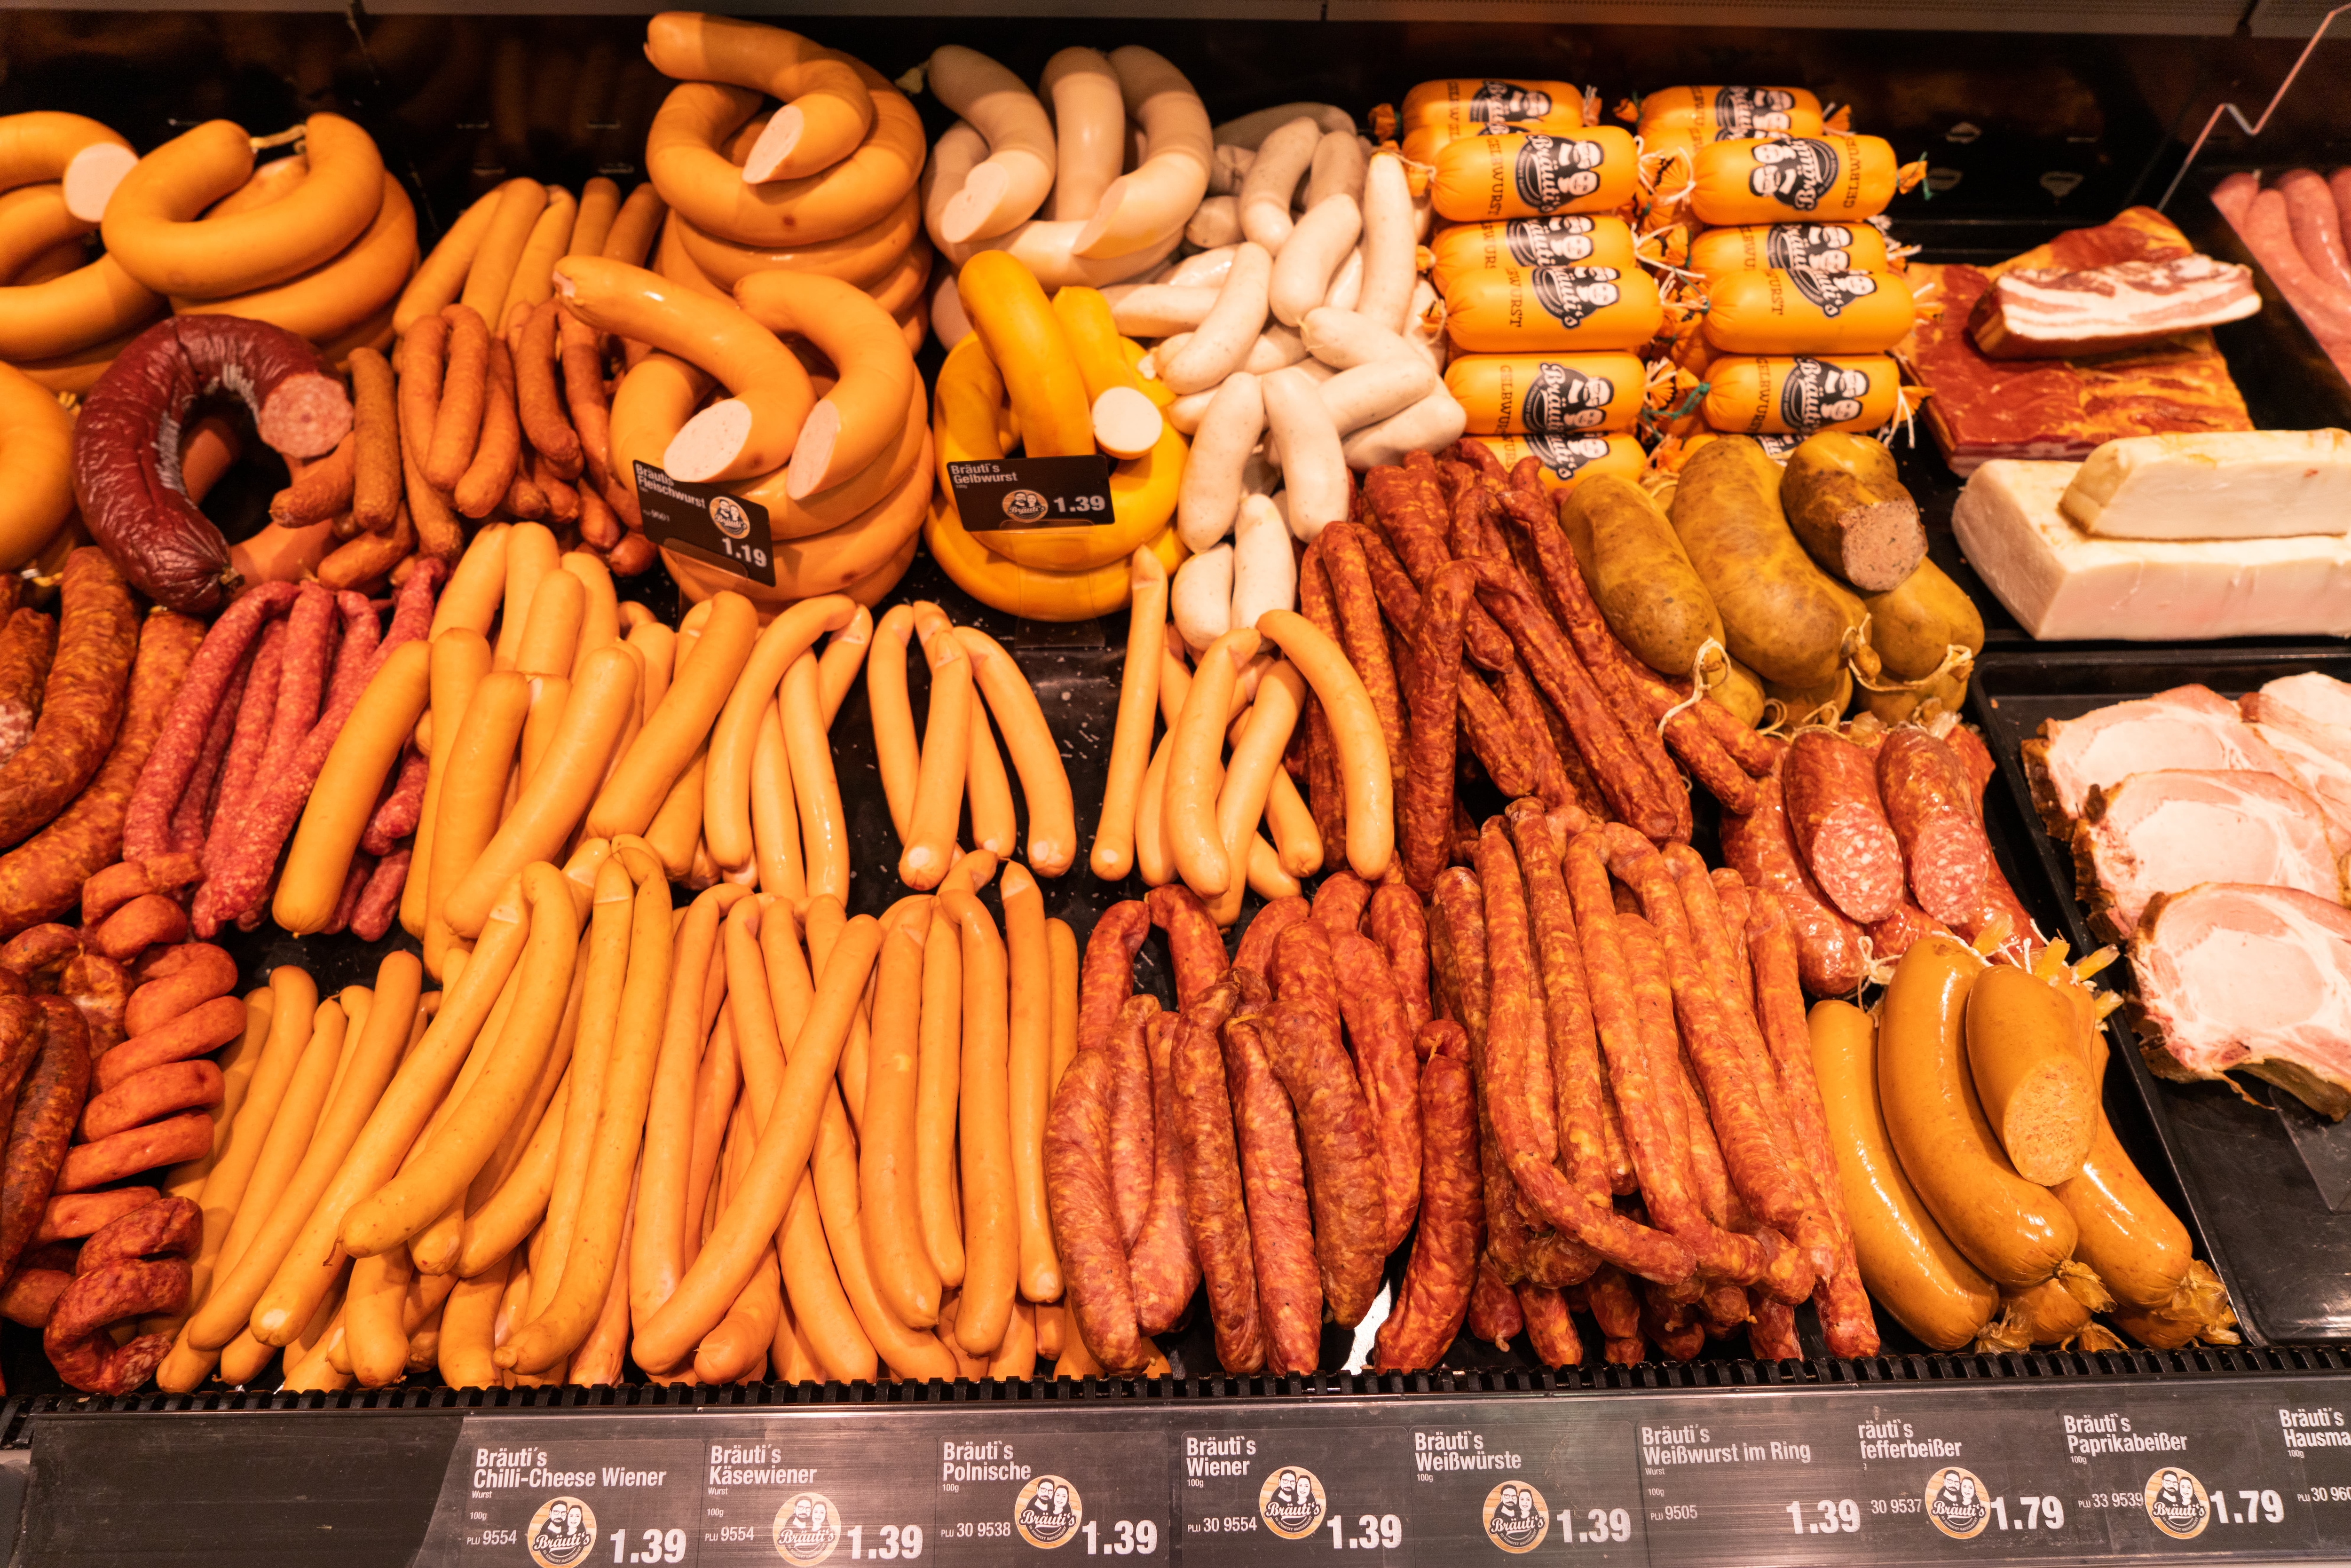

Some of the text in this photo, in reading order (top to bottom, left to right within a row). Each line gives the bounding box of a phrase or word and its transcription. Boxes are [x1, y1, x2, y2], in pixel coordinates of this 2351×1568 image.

[953, 472, 1018, 484] Gelbwurst
[637, 475, 706, 509] Fleischwurst
[1054, 495, 1105, 512] 1.39
[722, 537, 767, 567] 1.19
[2067, 1432, 2187, 1457] Paprikabeißer
[2283, 1429, 2351, 1447] Hausma
[1643, 1441, 1811, 1466] Weißwurst im Ring
[1860, 1438, 1962, 1459] fefferbeißer
[2288, 1450, 2304, 1458] 100g
[1187, 1457, 1250, 1477] Wiener
[1415, 1451, 1521, 1471] Weißwürste
[2070, 1456, 2087, 1465] 100g
[474, 1467, 667, 1488] Chilli-Cheese Wiener
[710, 1466, 817, 1485] Käsewiener
[943, 1461, 1031, 1481] Polnische
[1417, 1473, 1433, 1482] 100g
[942, 1484, 959, 1493] 100g
[1187, 1479, 1204, 1488] 100g
[1648, 1488, 1665, 1497] 100g
[2092, 1493, 2108, 1508] 33
[2111, 1492, 2144, 1507] 9539
[2311, 1487, 2328, 1502] 30
[707, 1508, 724, 1517] 100g
[1665, 1505, 1697, 1521] 9505
[1870, 1498, 1922, 1514] 30 9537
[1990, 1495, 2064, 1530] 1.79
[2210, 1489, 2284, 1523] 1.79
[470, 1512, 487, 1521] 100g
[1203, 1517, 1219, 1532] 30
[1223, 1516, 1257, 1531] 9554
[1556, 1508, 1631, 1543] 1.39
[1786, 1499, 1860, 1534] 1.39
[482, 1529, 517, 1545] 9554
[721, 1526, 754, 1541] 9554
[956, 1522, 973, 1537] 30
[977, 1522, 1010, 1537] 9538
[1082, 1520, 1157, 1554] 1.39
[1327, 1514, 1402, 1549] 1.39
[611, 1528, 686, 1563] 1.39
[847, 1524, 923, 1560] 1.39
